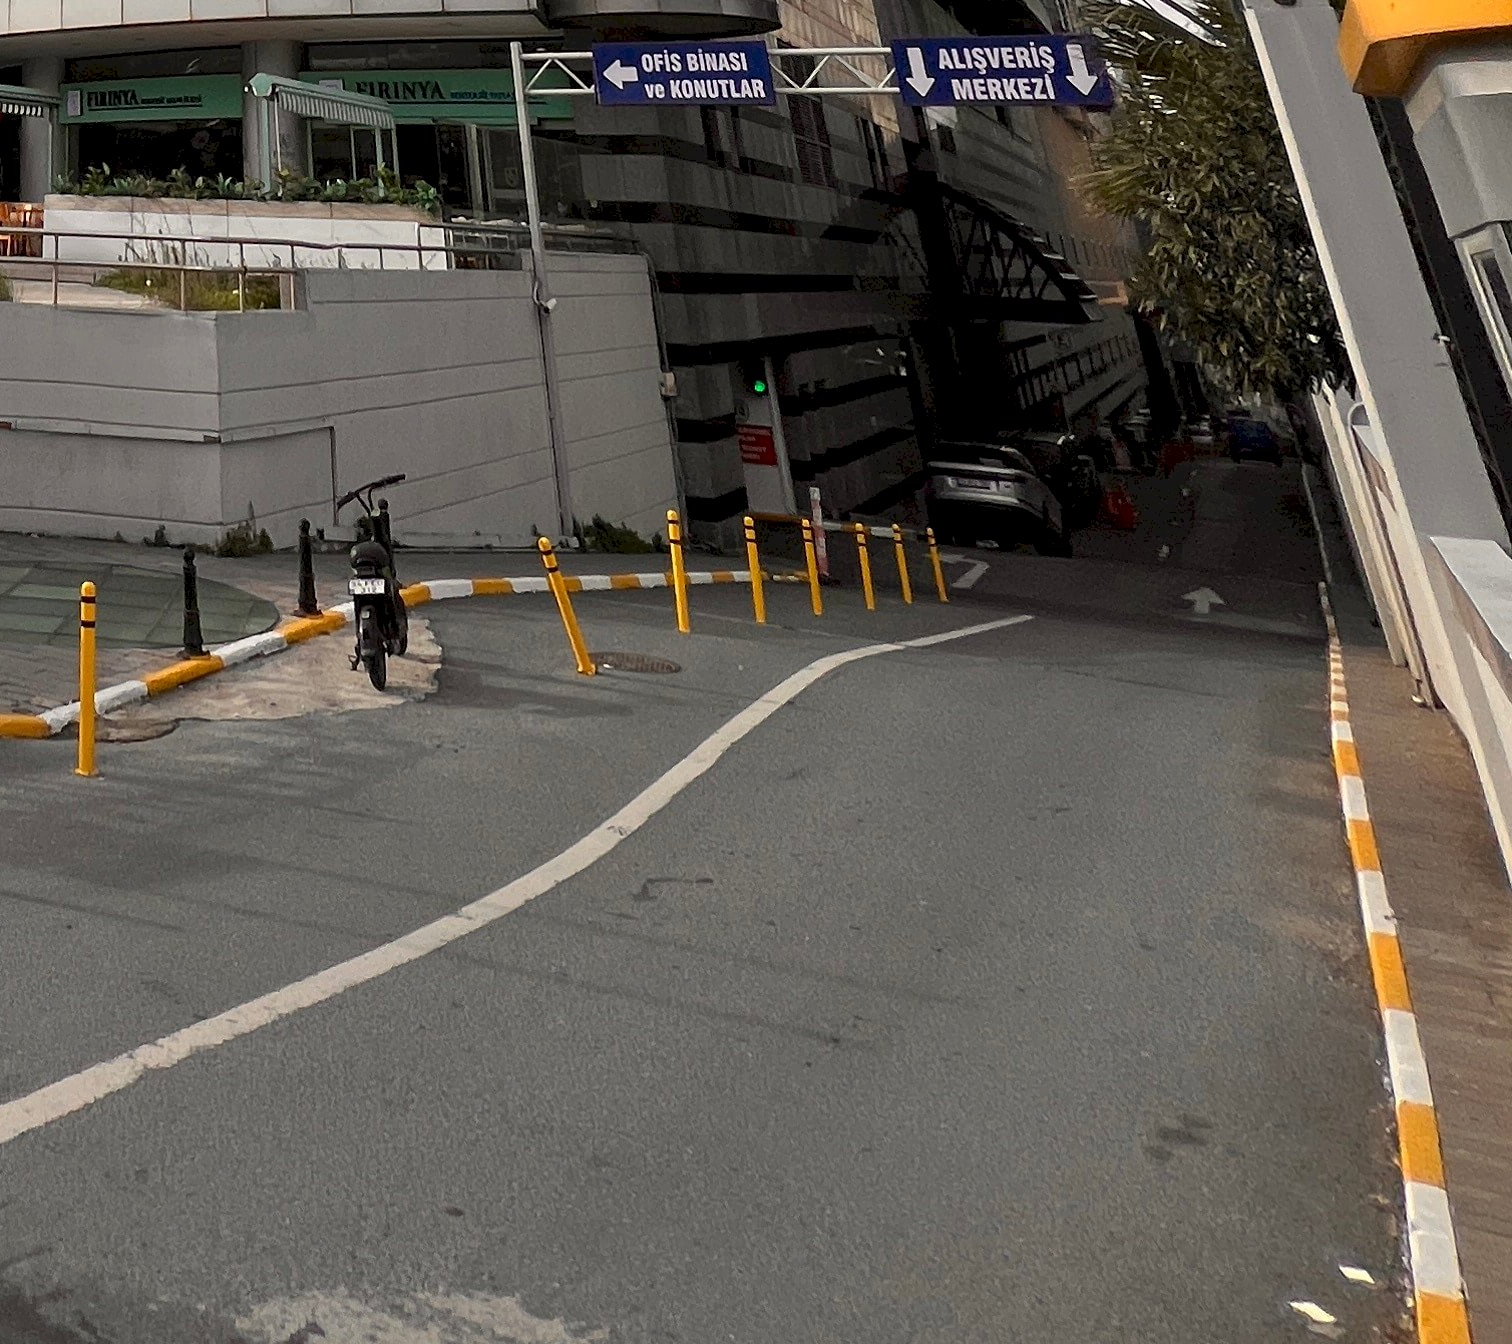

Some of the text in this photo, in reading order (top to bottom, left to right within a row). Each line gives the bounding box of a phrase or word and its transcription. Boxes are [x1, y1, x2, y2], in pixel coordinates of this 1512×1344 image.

[641, 50, 748, 74] OFİS BİNASI
[938, 41, 1055, 74] ALIŞVERİŞ
[645, 78, 766, 100] ve KONUTLAR
[951, 74, 1056, 100] MERKEZİ
